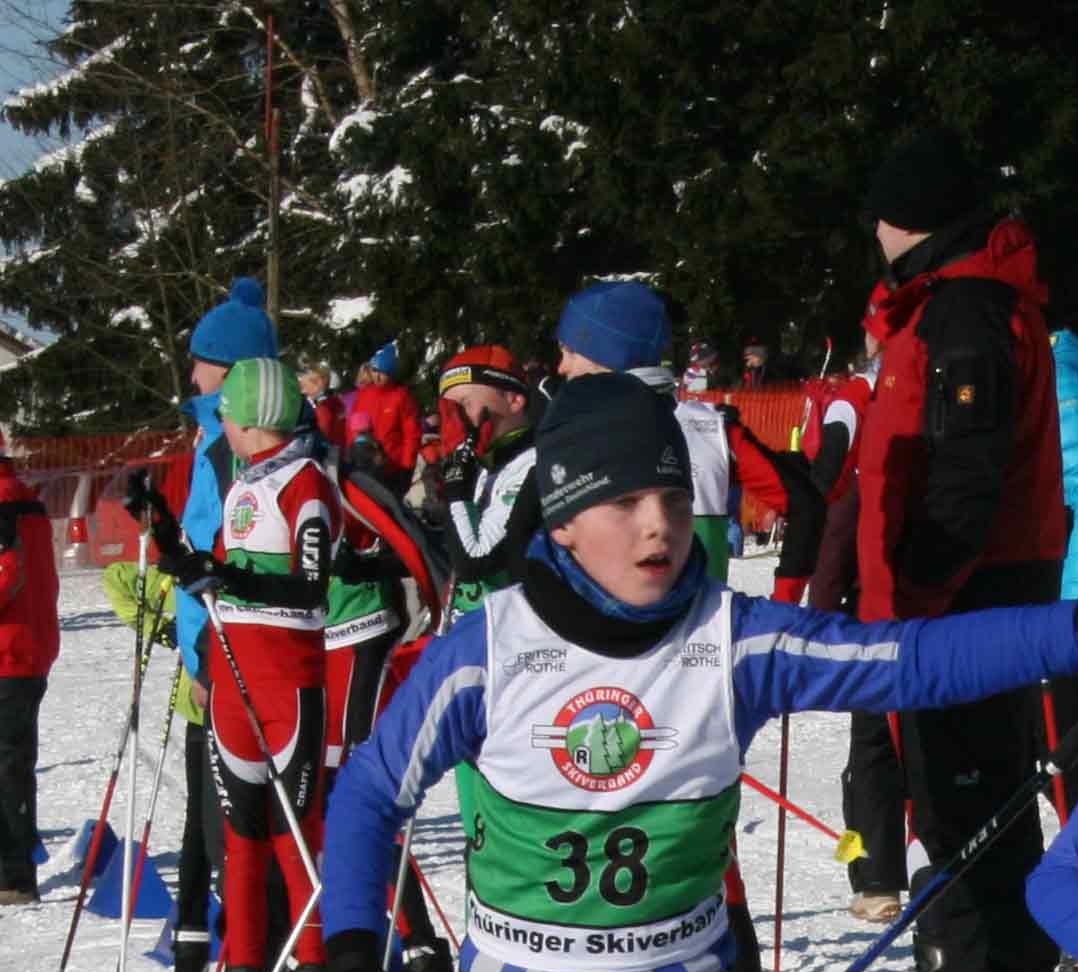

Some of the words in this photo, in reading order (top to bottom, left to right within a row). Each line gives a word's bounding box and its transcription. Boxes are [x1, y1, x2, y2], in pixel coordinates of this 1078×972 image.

[575, 750, 588, 764] R
[561, 761, 642, 790] SKIVERBAND
[545, 827, 650, 906] 38
